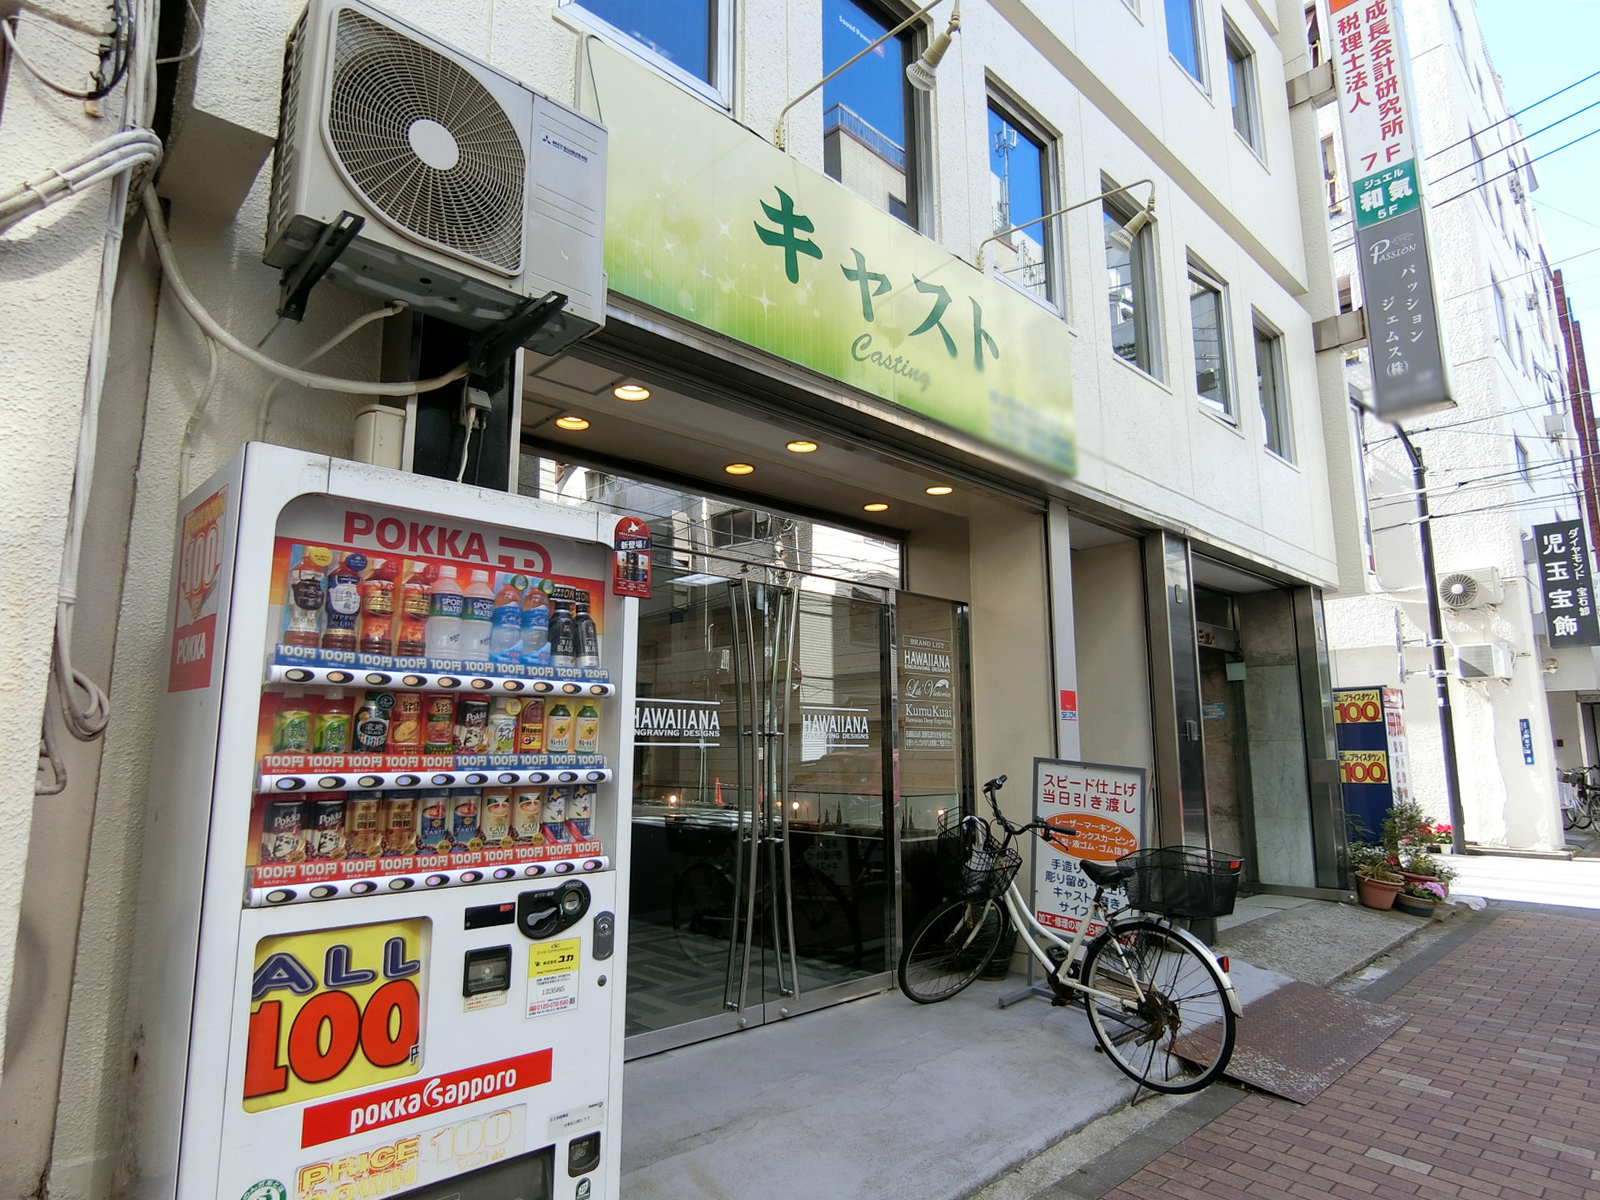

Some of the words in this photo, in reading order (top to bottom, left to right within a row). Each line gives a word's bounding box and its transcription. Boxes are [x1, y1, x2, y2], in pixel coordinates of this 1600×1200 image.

[1337, 15, 1372, 114] 税理士法人
[1365, 0, 1404, 141] 成長会計研究所
[1363, 167, 1404, 190] ジュエル
[1377, 204, 1399, 220] 5F
[753, 185, 1000, 373] キャスト
[850, 333, 932, 393] Casting
[342, 511, 489, 564] POKKA
[1542, 533, 1578, 637] 児玉宝飾
[176, 632, 206, 665] POKKA
[910, 638, 931, 648] BRAND
[932, 640, 945, 649] LIST
[278, 645, 316, 659] 100円
[320, 649, 355, 664] 100円
[358, 653, 392, 667] 100円
[394, 657, 427, 669] 100円
[431, 659, 462, 671] 100円
[904, 650, 950, 669] HAWAIIANA
[465, 661, 494, 673] 100円
[497, 663, 525, 675] 100円
[527, 666, 554, 677] 100円
[556, 668, 581, 678] 120円
[584, 669, 608, 679] 120円
[905, 703, 952, 719] KumuKuai
[802, 714, 869, 733] HAWAIIANA
[634, 729, 679, 738] NGRAVING
[684, 729, 720, 738] DESIGNS
[264, 756, 304, 768] 100円
[308, 756, 344, 768] 100円
[348, 756, 383, 767] 100円
[386, 756, 419, 767] 100円
[421, 756, 453, 767] 100円
[456, 755, 487, 766] 100円
[489, 755, 518, 766] 100円
[520, 755, 548, 765] 100円
[550, 755, 576, 765] 100円
[577, 754, 603, 765] 100円
[1043, 773, 1137, 798] スピード仕上げ
[1042, 789, 1136, 814] 当日引き渡し
[1054, 817, 1122, 833] レーザーマーキング
[516, 847, 544, 858] 100円
[546, 843, 572, 855] 100円
[574, 841, 600, 852] 100円
[416, 855, 447, 867] 100円
[451, 852, 481, 864] 100円
[484, 850, 513, 861] 100円
[301, 862, 337, 876] 100円
[341, 860, 376, 873] 100円
[379, 857, 413, 870] 100円
[257, 865, 296, 879] 100円
[252, 935, 420, 1000] ALL
[298, 1134, 421, 1193] PRICE
